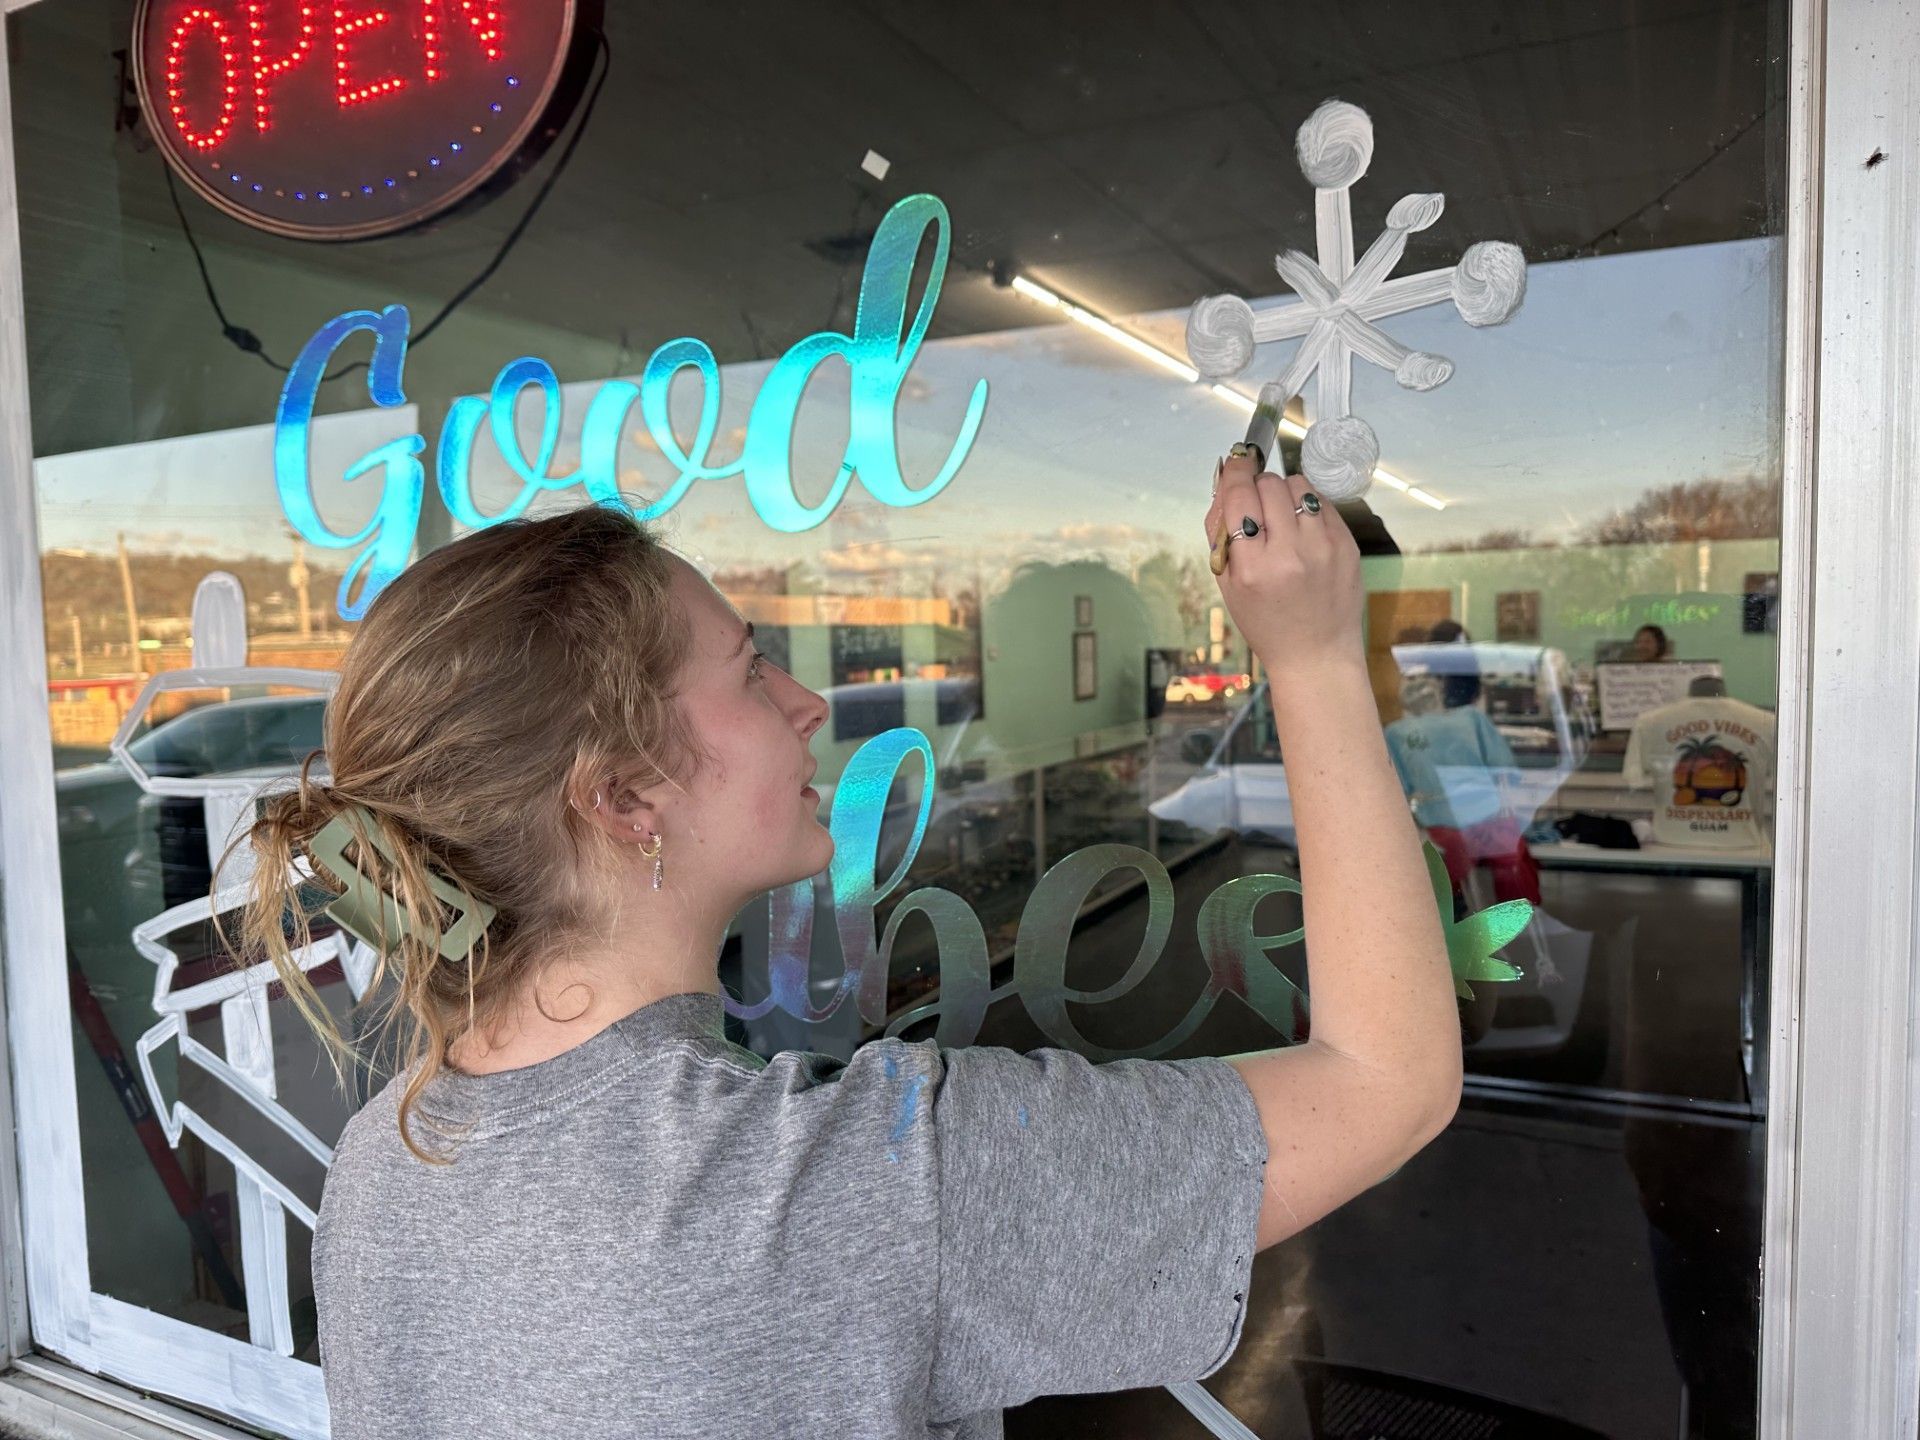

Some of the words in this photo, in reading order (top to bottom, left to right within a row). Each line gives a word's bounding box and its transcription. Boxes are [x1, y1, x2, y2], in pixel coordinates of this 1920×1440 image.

[164, 0, 503, 152] OPEN
[274, 193, 988, 621] Good
[1665, 719, 1710, 743] GOOD
[1713, 719, 1759, 745] VIBES
[1665, 807, 1752, 820] DISPENSARY
[1689, 822, 1728, 832] GUAM
